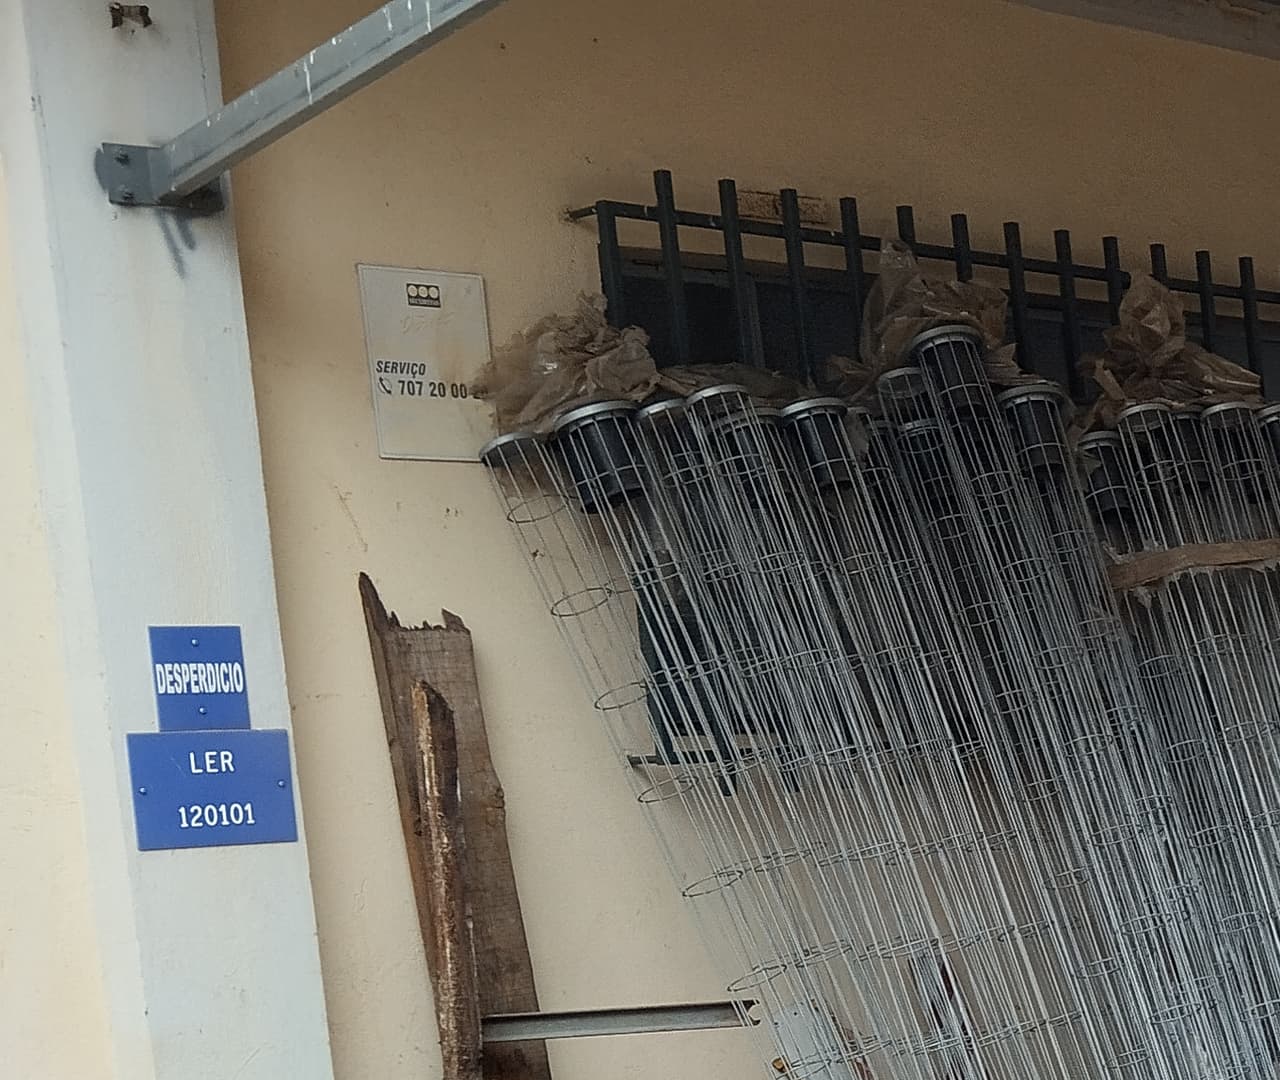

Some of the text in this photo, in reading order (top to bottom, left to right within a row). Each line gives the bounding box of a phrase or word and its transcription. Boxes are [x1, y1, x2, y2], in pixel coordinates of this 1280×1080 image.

[375, 360, 426, 378] SERVIÇO
[398, 380, 423, 396] 707
[429, 382, 446, 397] 20
[450, 383, 468, 399] 00
[155, 662, 244, 694] DESPERDICIO
[188, 751, 235, 774] LER
[178, 803, 256, 828] 120101
